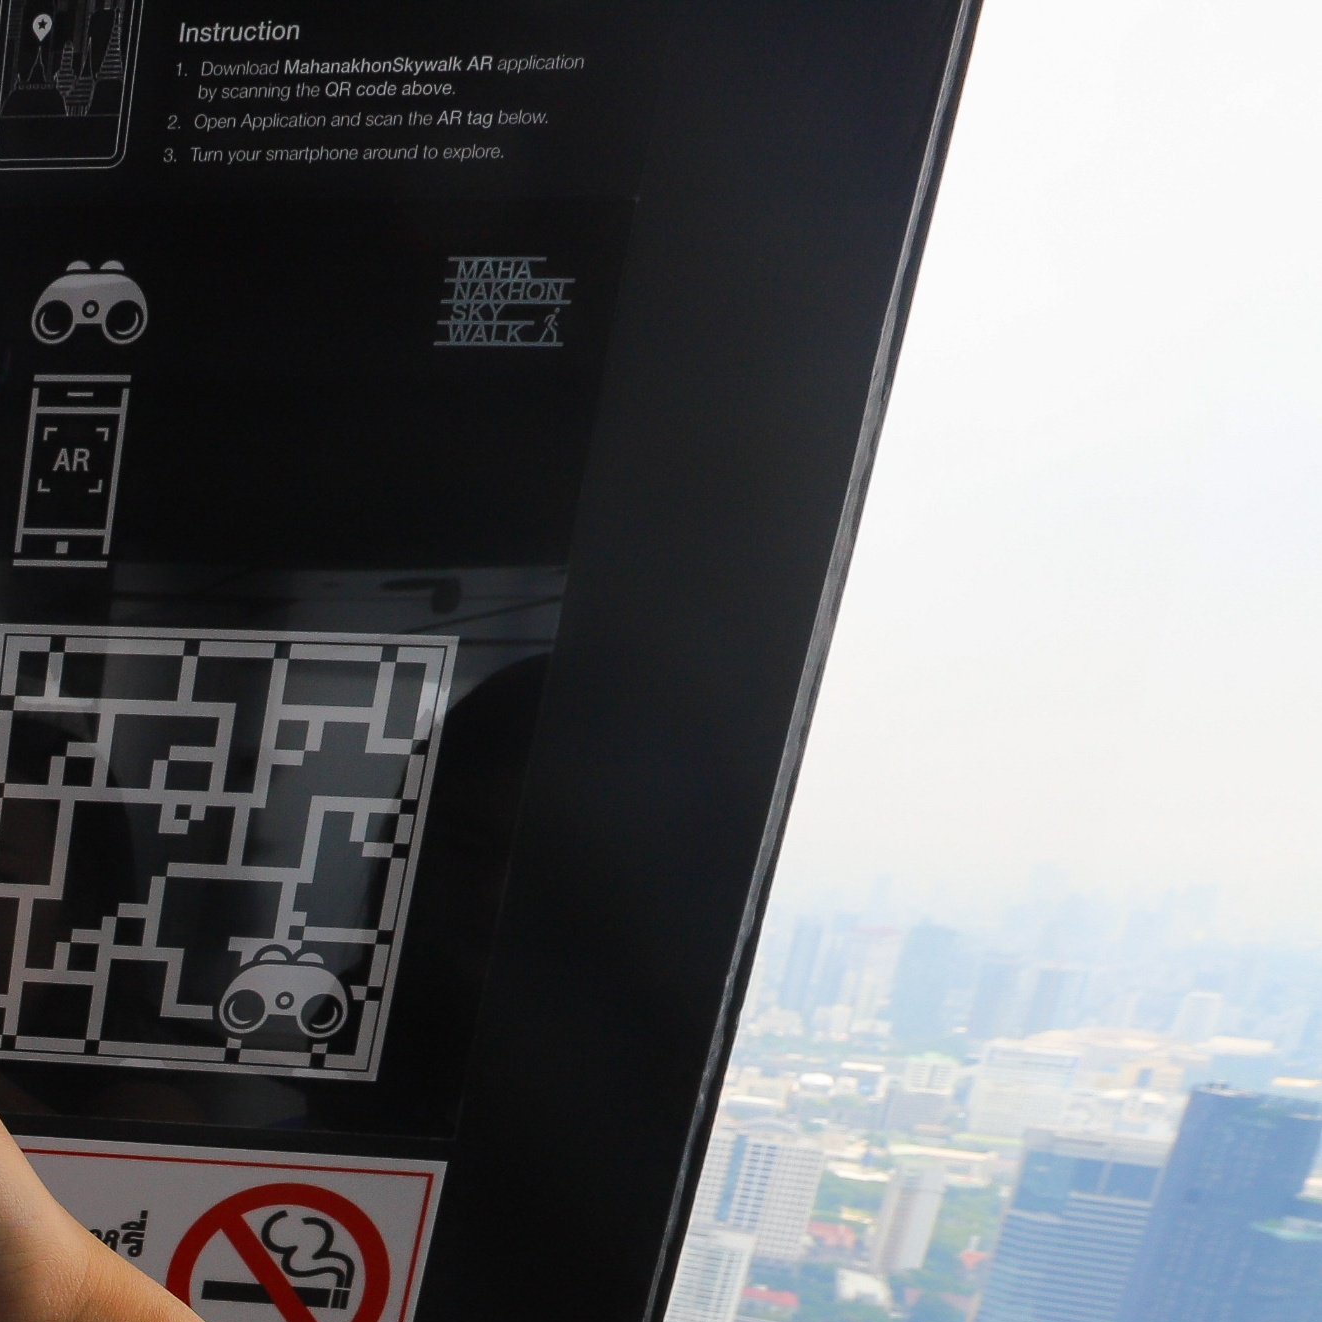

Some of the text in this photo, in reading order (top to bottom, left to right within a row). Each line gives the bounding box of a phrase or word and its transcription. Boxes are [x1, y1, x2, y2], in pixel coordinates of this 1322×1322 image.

[179, 20, 299, 42] Instruction
[201, 59, 279, 76] Download
[284, 56, 462, 76] MahanakhonSkywalk
[466, 55, 492, 71] AR
[497, 54, 584, 73] application
[198, 80, 455, 102] by scanning the QR code above.
[194, 113, 236, 132] Open
[240, 113, 326, 131] Application
[330, 111, 361, 127] and
[365, 114, 402, 126] scan
[408, 111, 432, 125] the
[436, 109, 462, 125] AR
[467, 110, 493, 129] tag
[497, 109, 547, 124] below.
[190, 146, 222, 162] Turn
[227, 149, 261, 164] your
[265, 145, 358, 163] smartphone
[362, 144, 418, 160] around
[423, 145, 438, 159] to
[442, 143, 503, 162] explore.
[457, 260, 531, 280] MAHA
[453, 281, 565, 301] NAKHON
[451, 302, 507, 322] SKY
[449, 323, 525, 343] WALK
[52, 447, 90, 471] AR
